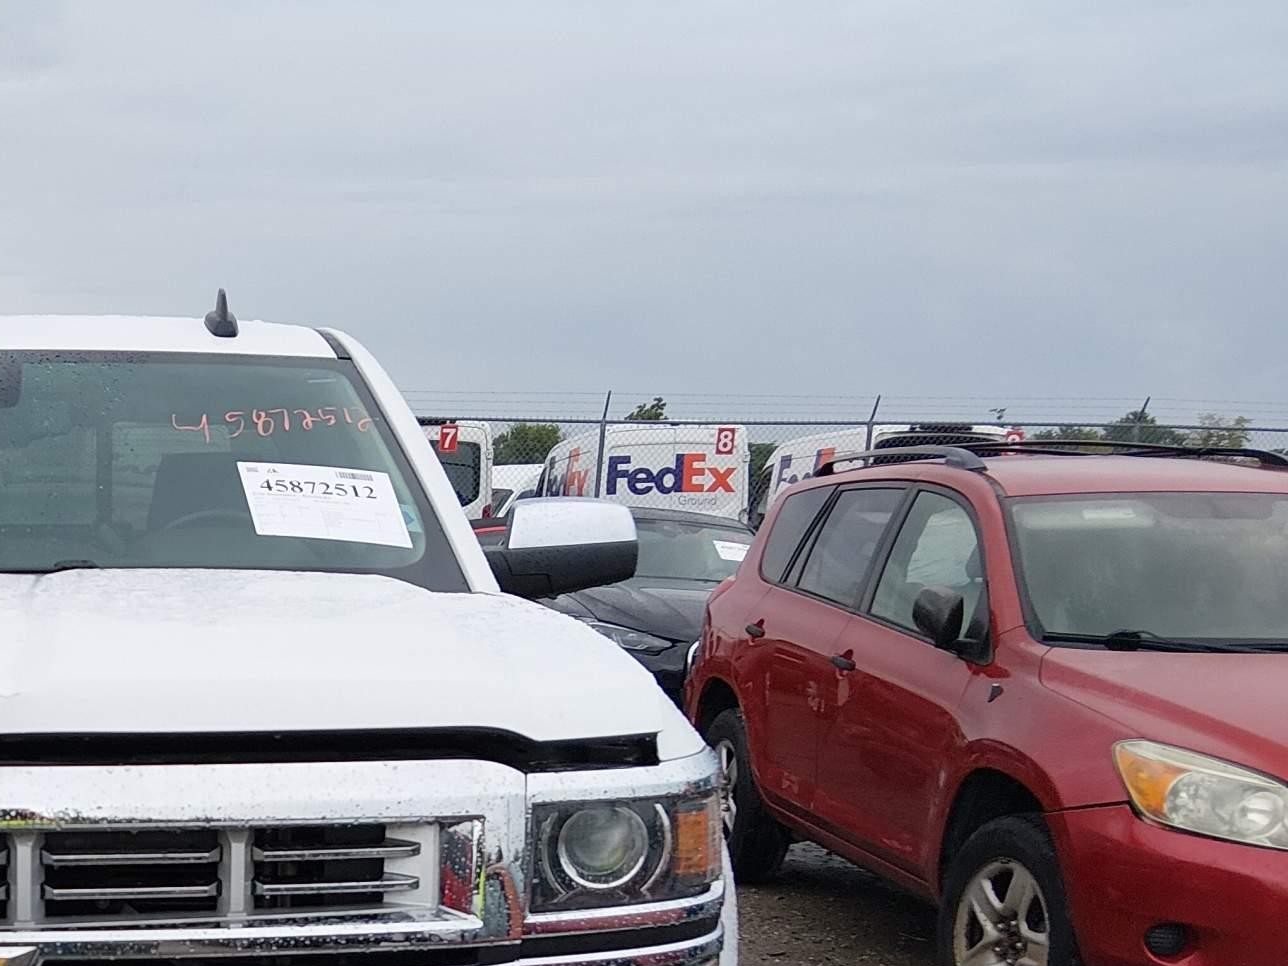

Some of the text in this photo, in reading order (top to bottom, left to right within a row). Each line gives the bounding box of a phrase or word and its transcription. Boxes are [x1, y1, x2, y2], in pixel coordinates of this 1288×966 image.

[172, 407, 379, 444] 45872512
[442, 427, 456, 449] 7
[718, 431, 734, 452] 8
[606, 453, 736, 496] FedEx
[260, 478, 377, 499] 45872512
[678, 495, 717, 506] Ground
